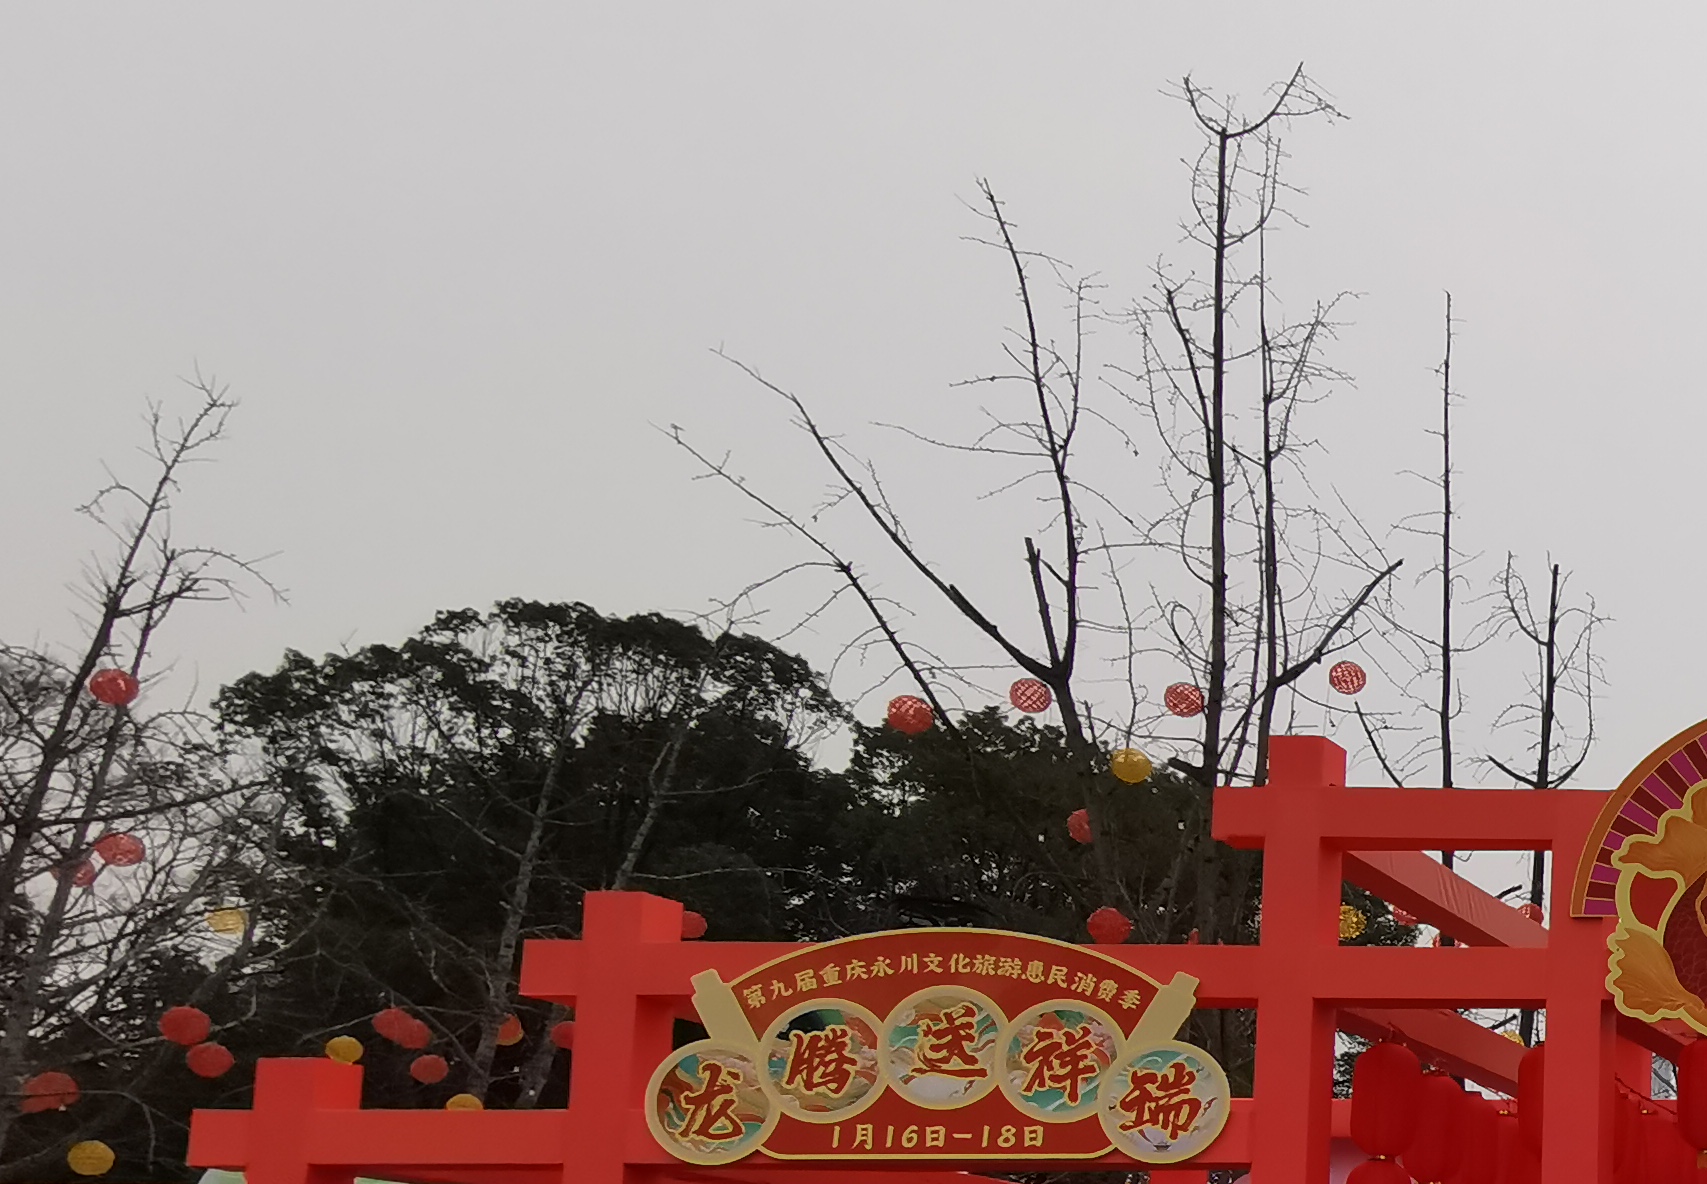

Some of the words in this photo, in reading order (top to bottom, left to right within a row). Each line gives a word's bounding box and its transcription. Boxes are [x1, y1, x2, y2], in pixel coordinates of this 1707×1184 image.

[742, 953, 1142, 1010] 第九届重庆永川文化旅游惠民消费季
[677, 1002, 1203, 1142] 龙腾送祥瑞
